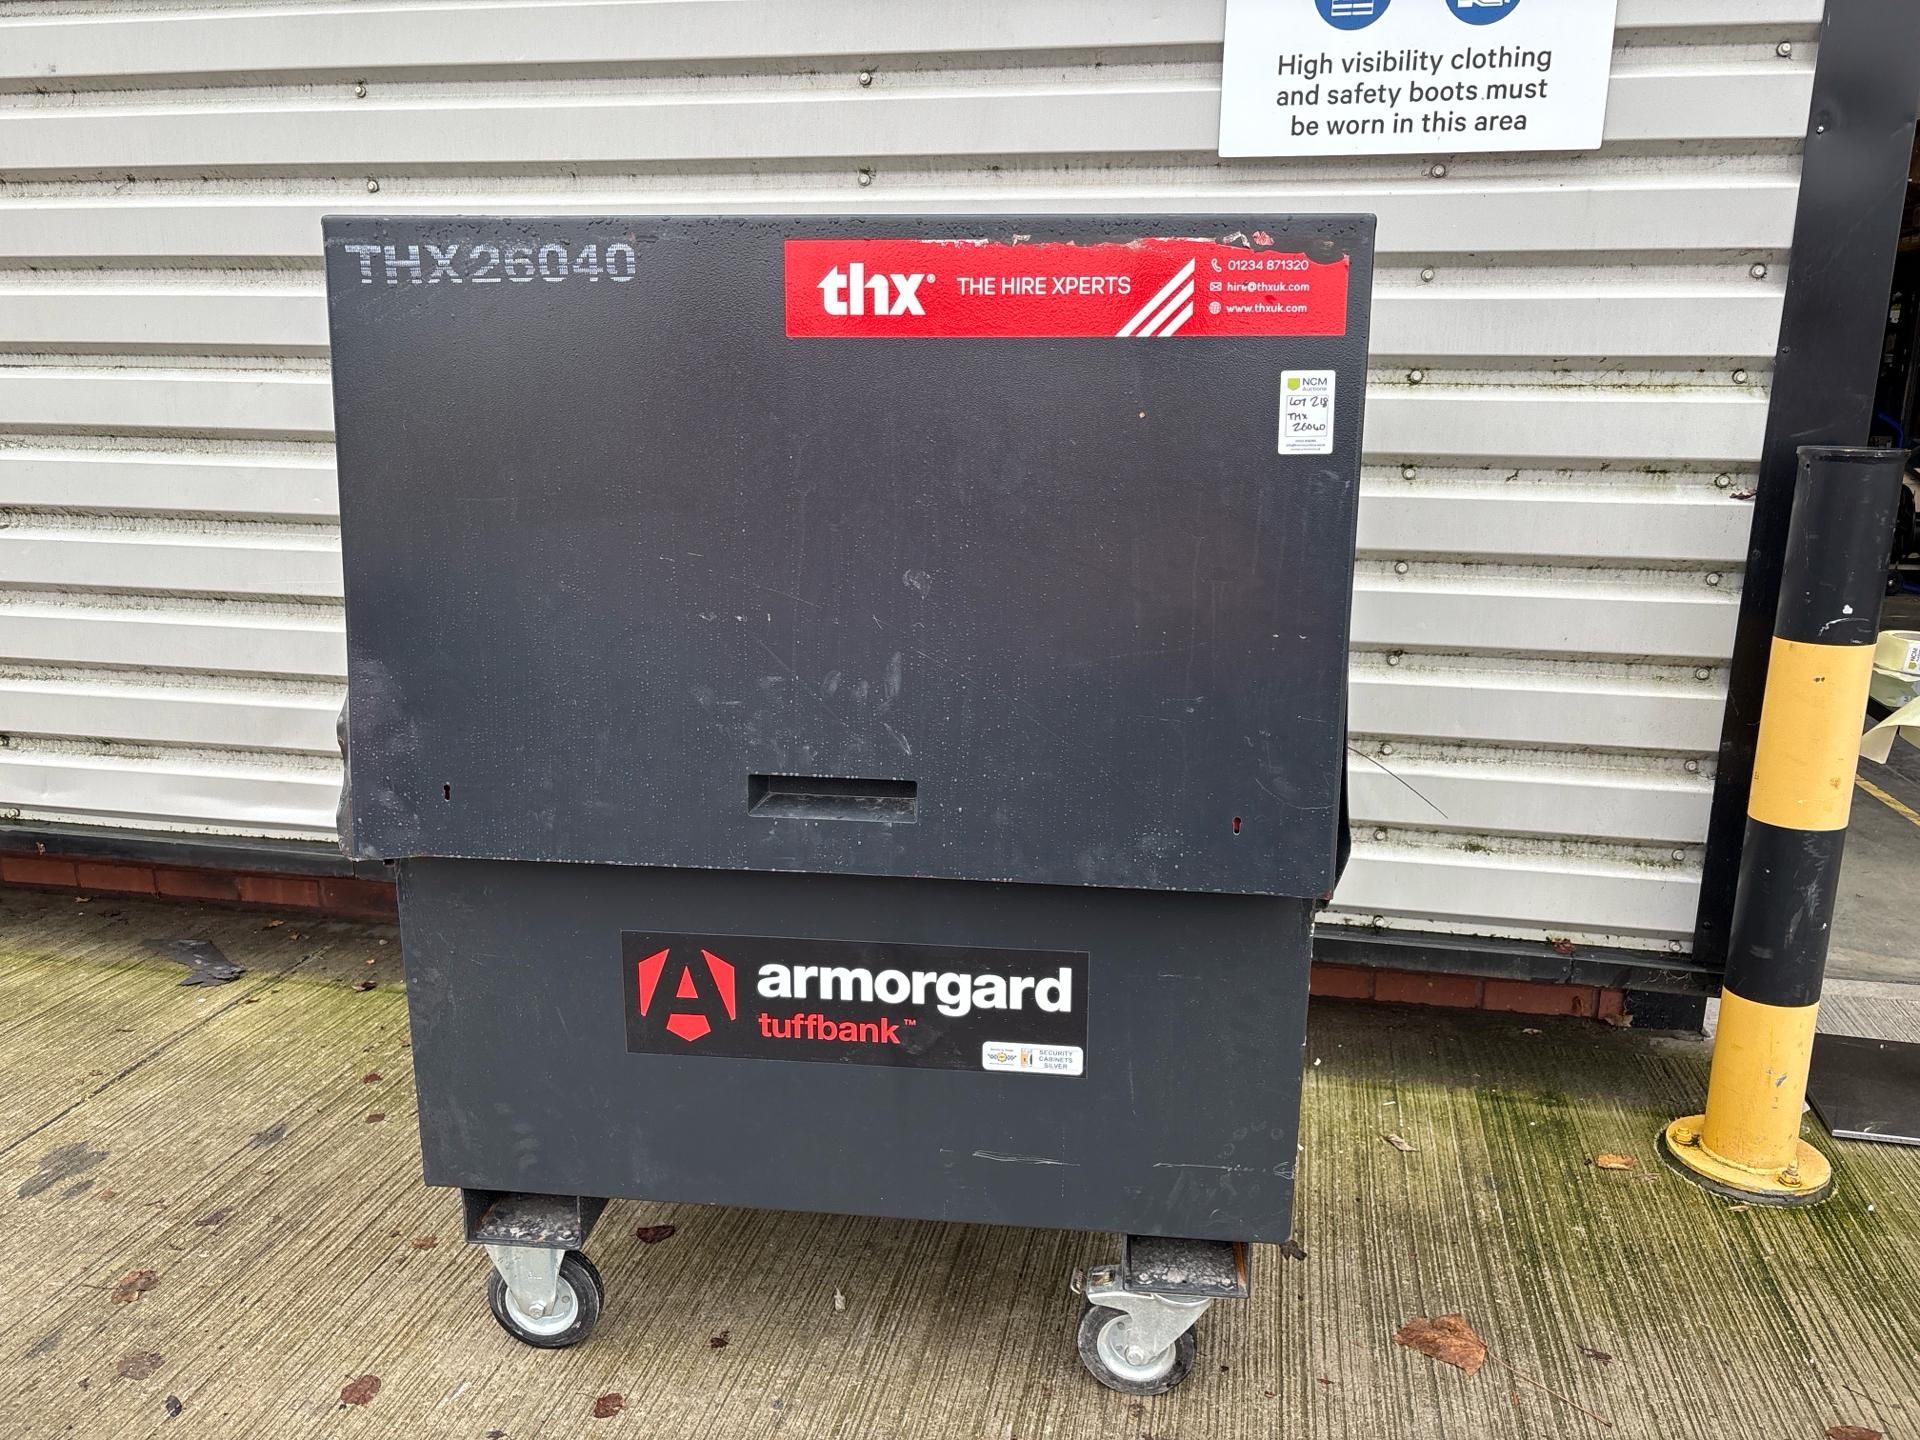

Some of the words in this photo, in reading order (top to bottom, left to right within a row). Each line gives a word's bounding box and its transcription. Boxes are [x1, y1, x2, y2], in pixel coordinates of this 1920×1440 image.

[1278, 54, 1333, 80] High
[1342, 50, 1444, 76] visibility
[1451, 46, 1553, 72] clothing
[1276, 85, 1319, 106] and
[1327, 82, 1401, 108] safety
[1409, 81, 1478, 102] boots
[1486, 79, 1549, 100] must
[1290, 115, 1319, 137] be
[1327, 115, 1385, 135] worn
[1393, 112, 1414, 134] in
[1422, 110, 1467, 133] this
[1474, 113, 1528, 132] area
[1227, 260, 1264, 271] 01234
[1266, 260, 1309, 271] 871320
[957, 277, 996, 296] THE
[1001, 276, 1047, 295] HIRE
[1051, 275, 1132, 295] XPERTS
[1226, 302, 1308, 313] www.thxuk.com
[1302, 377, 1328, 386] NCM
[1310, 396, 1329, 408] 218
[1292, 422, 1326, 432] 26040
[757, 961, 1072, 1017] armorgard
[1039, 1049, 1073, 1057] SECURITY
